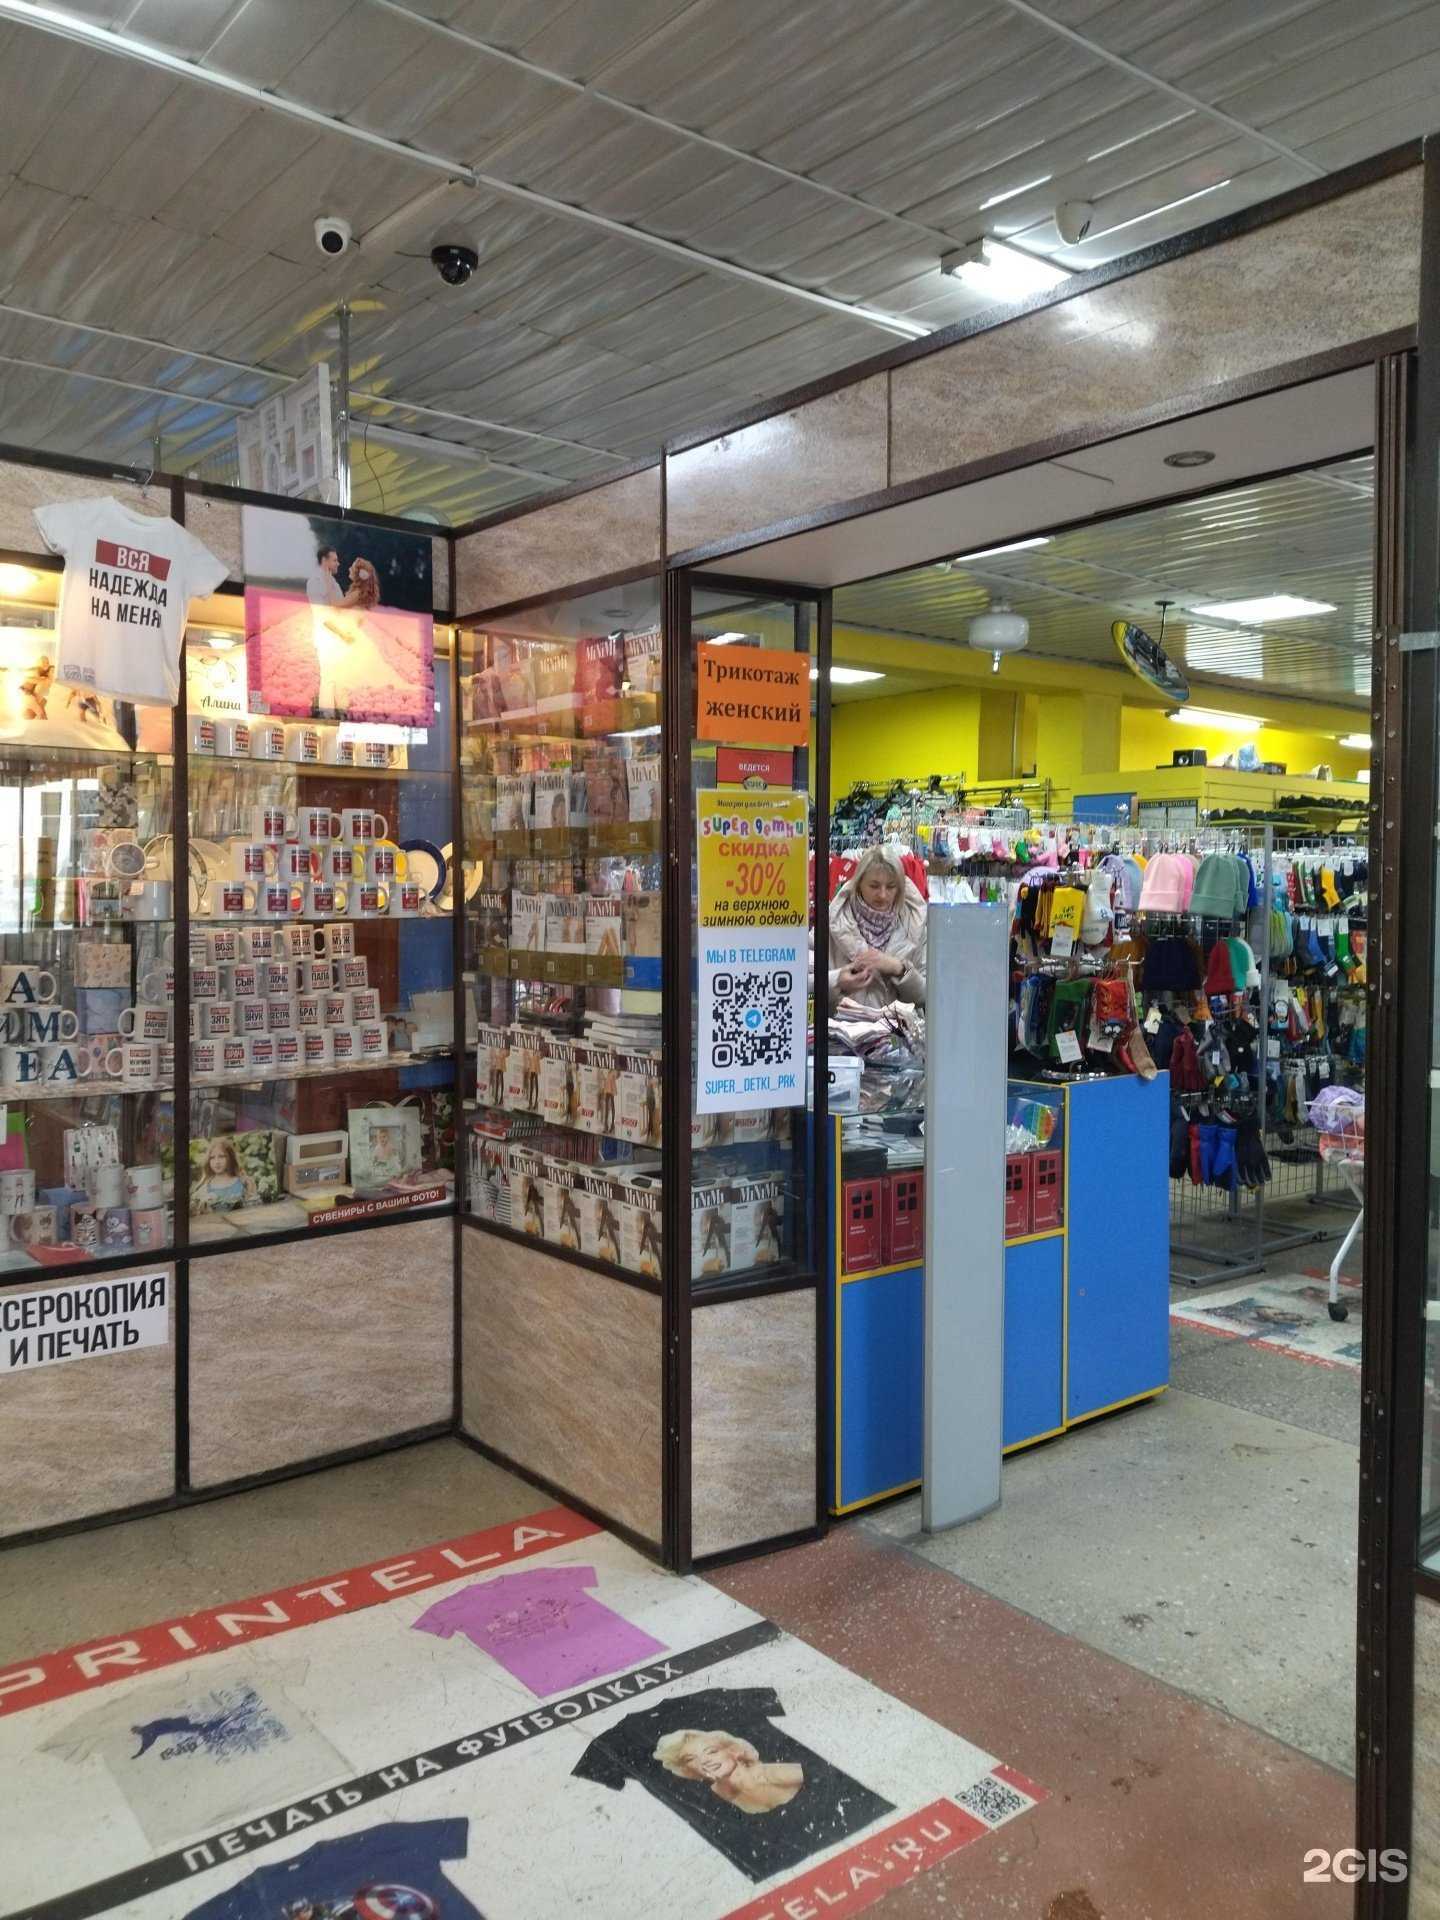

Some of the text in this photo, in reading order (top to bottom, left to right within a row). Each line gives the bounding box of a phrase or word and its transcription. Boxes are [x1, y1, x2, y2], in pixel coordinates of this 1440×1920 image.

[116, 546, 150, 572] ВСЯ
[89, 568, 168, 607] НАДЕЖДА
[91, 596, 162, 628] НА МЕНЯ
[704, 659, 800, 685] Трикотаж
[200, 695, 241, 710] Алина
[706, 701, 801, 722] женский
[738, 763, 770, 772] ВЕДЕТСЯ
[702, 816, 749, 836] SUPER
[718, 842, 790, 859] СКИДКА
[726, 862, 786, 896] -30%
[714, 900, 790, 913] на верхнюю
[703, 911, 805, 927] зимнюю одежду
[706, 947, 796, 963] МЫ В TELEGRAM
[705, 1074, 796, 1095] SUPER_DETKI_PRK
[312, 1190, 440, 1224] СУВЕНИРЫ С ВАШИМ ФОТО!
[0, 1277, 166, 1332] СЕРОКОПИЯ
[10, 1319, 140, 1367] И ПЕЧАТЬ
[182, 1661, 684, 1873] ПЕЧАТЬ НА ФУТБОЛКАХ
